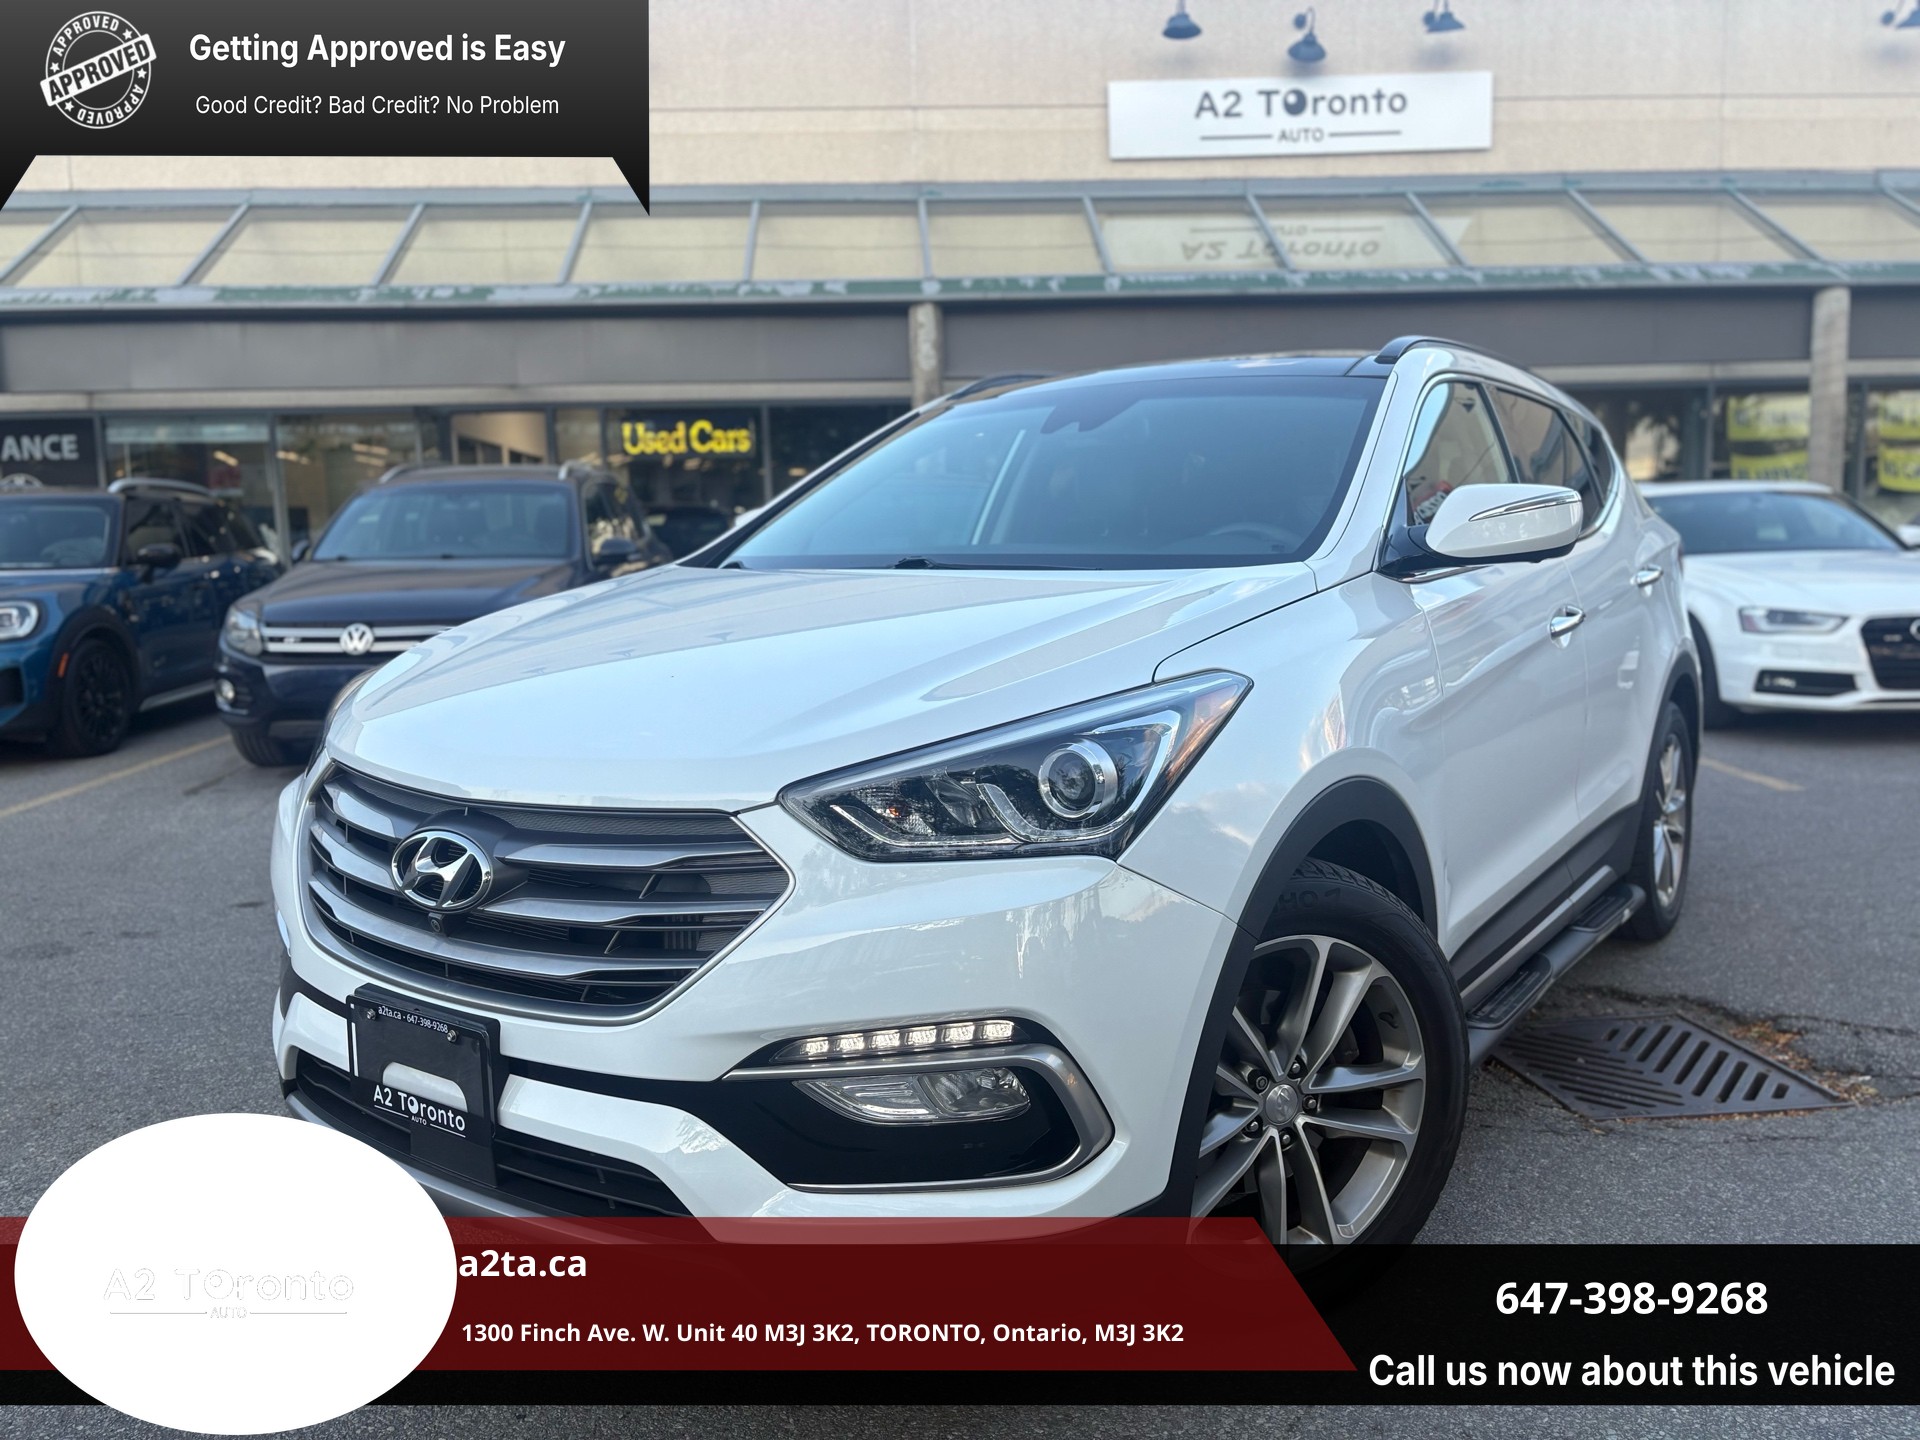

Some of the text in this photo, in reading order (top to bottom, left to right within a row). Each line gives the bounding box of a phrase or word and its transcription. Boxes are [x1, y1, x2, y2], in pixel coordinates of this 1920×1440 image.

[1194, 89, 1243, 119] A2
[1277, 127, 1325, 143] AUTO
[1, 433, 80, 462] ANCE
[621, 418, 752, 455] Used Cars
[378, 1005, 402, 1020] a2ta.ca
[406, 1013, 449, 1034] 647-398-9268
[373, 1084, 393, 1107] A2
[411, 1115, 428, 1126] AUTO
